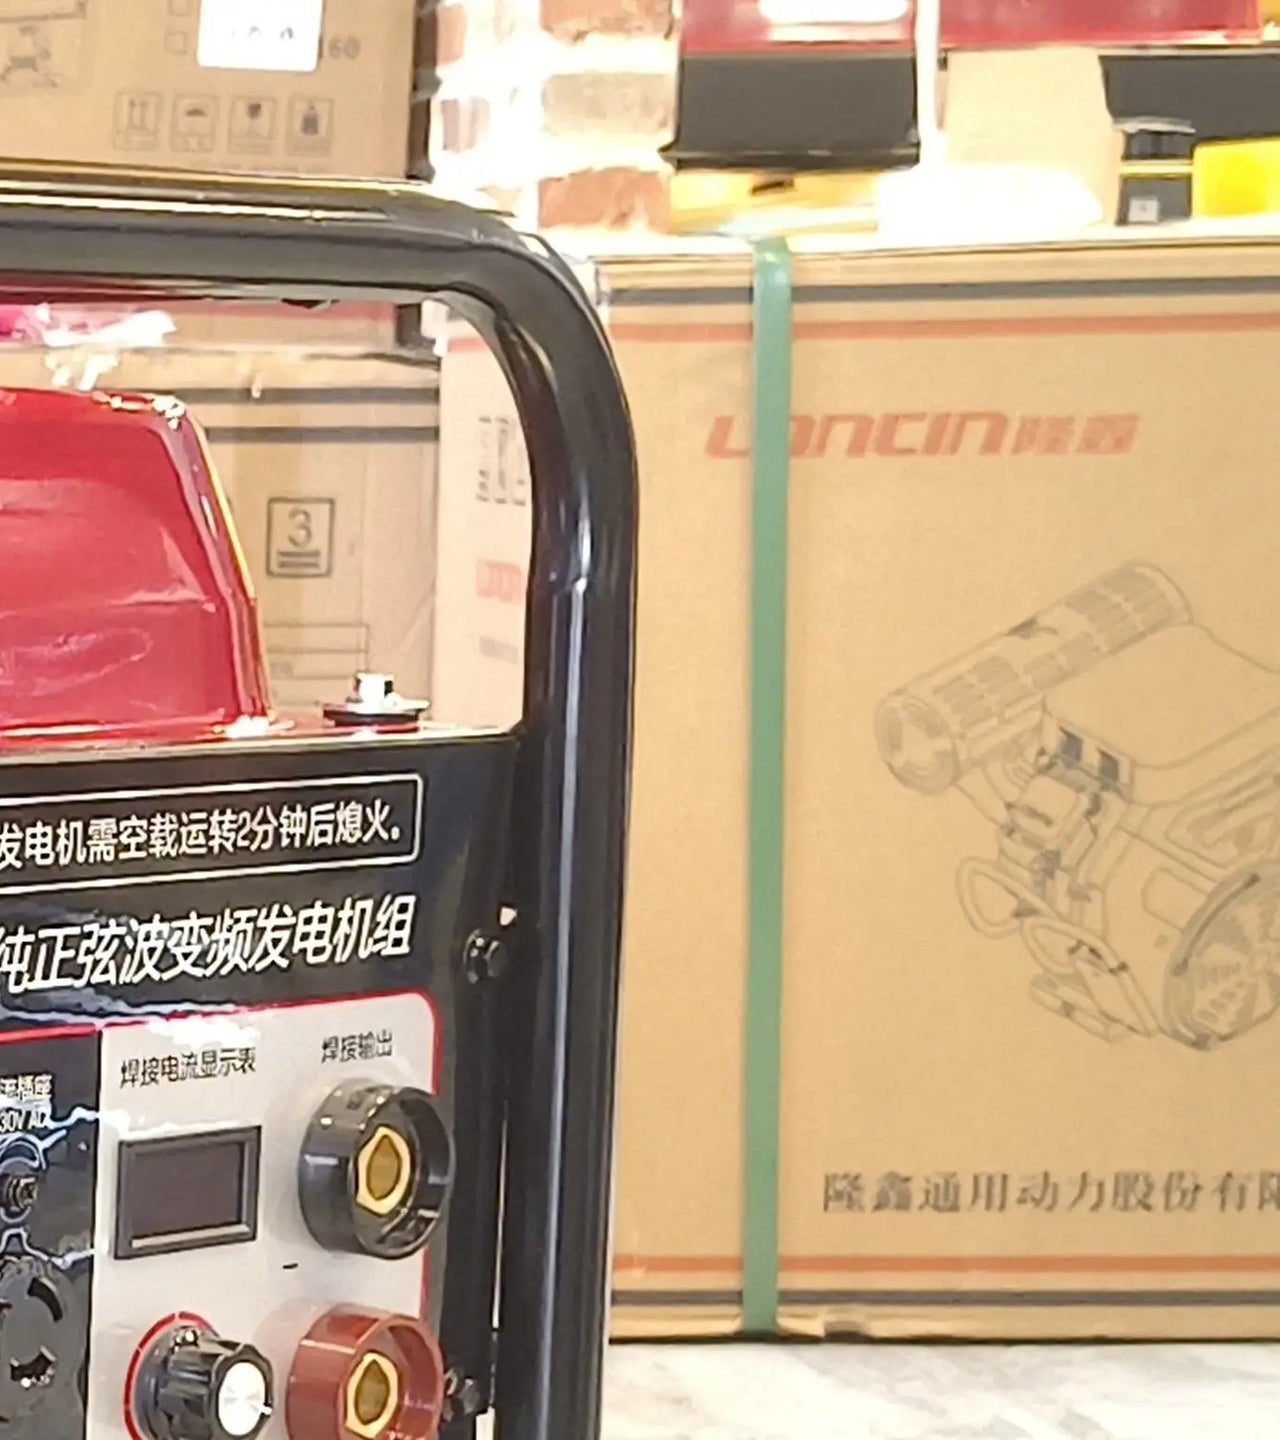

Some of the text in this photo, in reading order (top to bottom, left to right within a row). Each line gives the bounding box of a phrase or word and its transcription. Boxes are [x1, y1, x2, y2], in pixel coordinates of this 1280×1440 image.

[320, 1029, 393, 1064] 焊接输出
[119, 1047, 256, 1089] 焊接电流显示表
